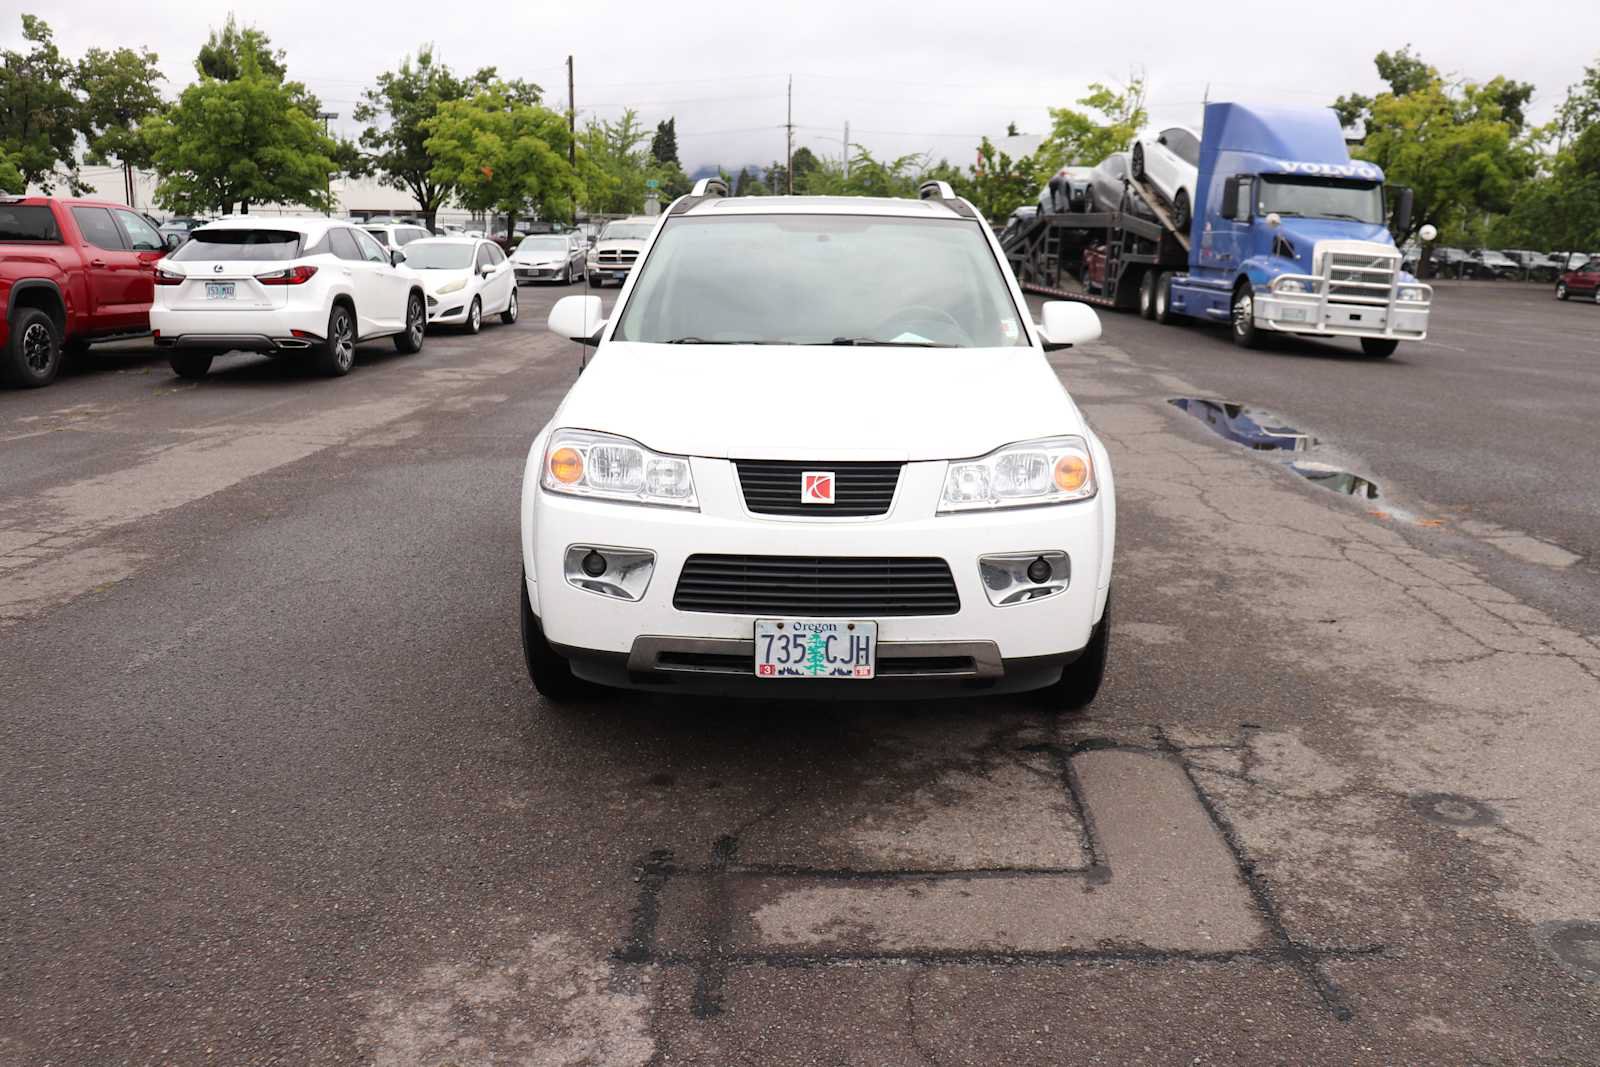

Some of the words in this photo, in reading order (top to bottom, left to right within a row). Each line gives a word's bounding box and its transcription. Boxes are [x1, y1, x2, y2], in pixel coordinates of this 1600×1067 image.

[1279, 161, 1376, 179] VOLVO
[793, 621, 838, 633] Oregon
[761, 634, 807, 664] 735
[825, 634, 870, 665] CJH
[764, 665, 771, 674] 3
